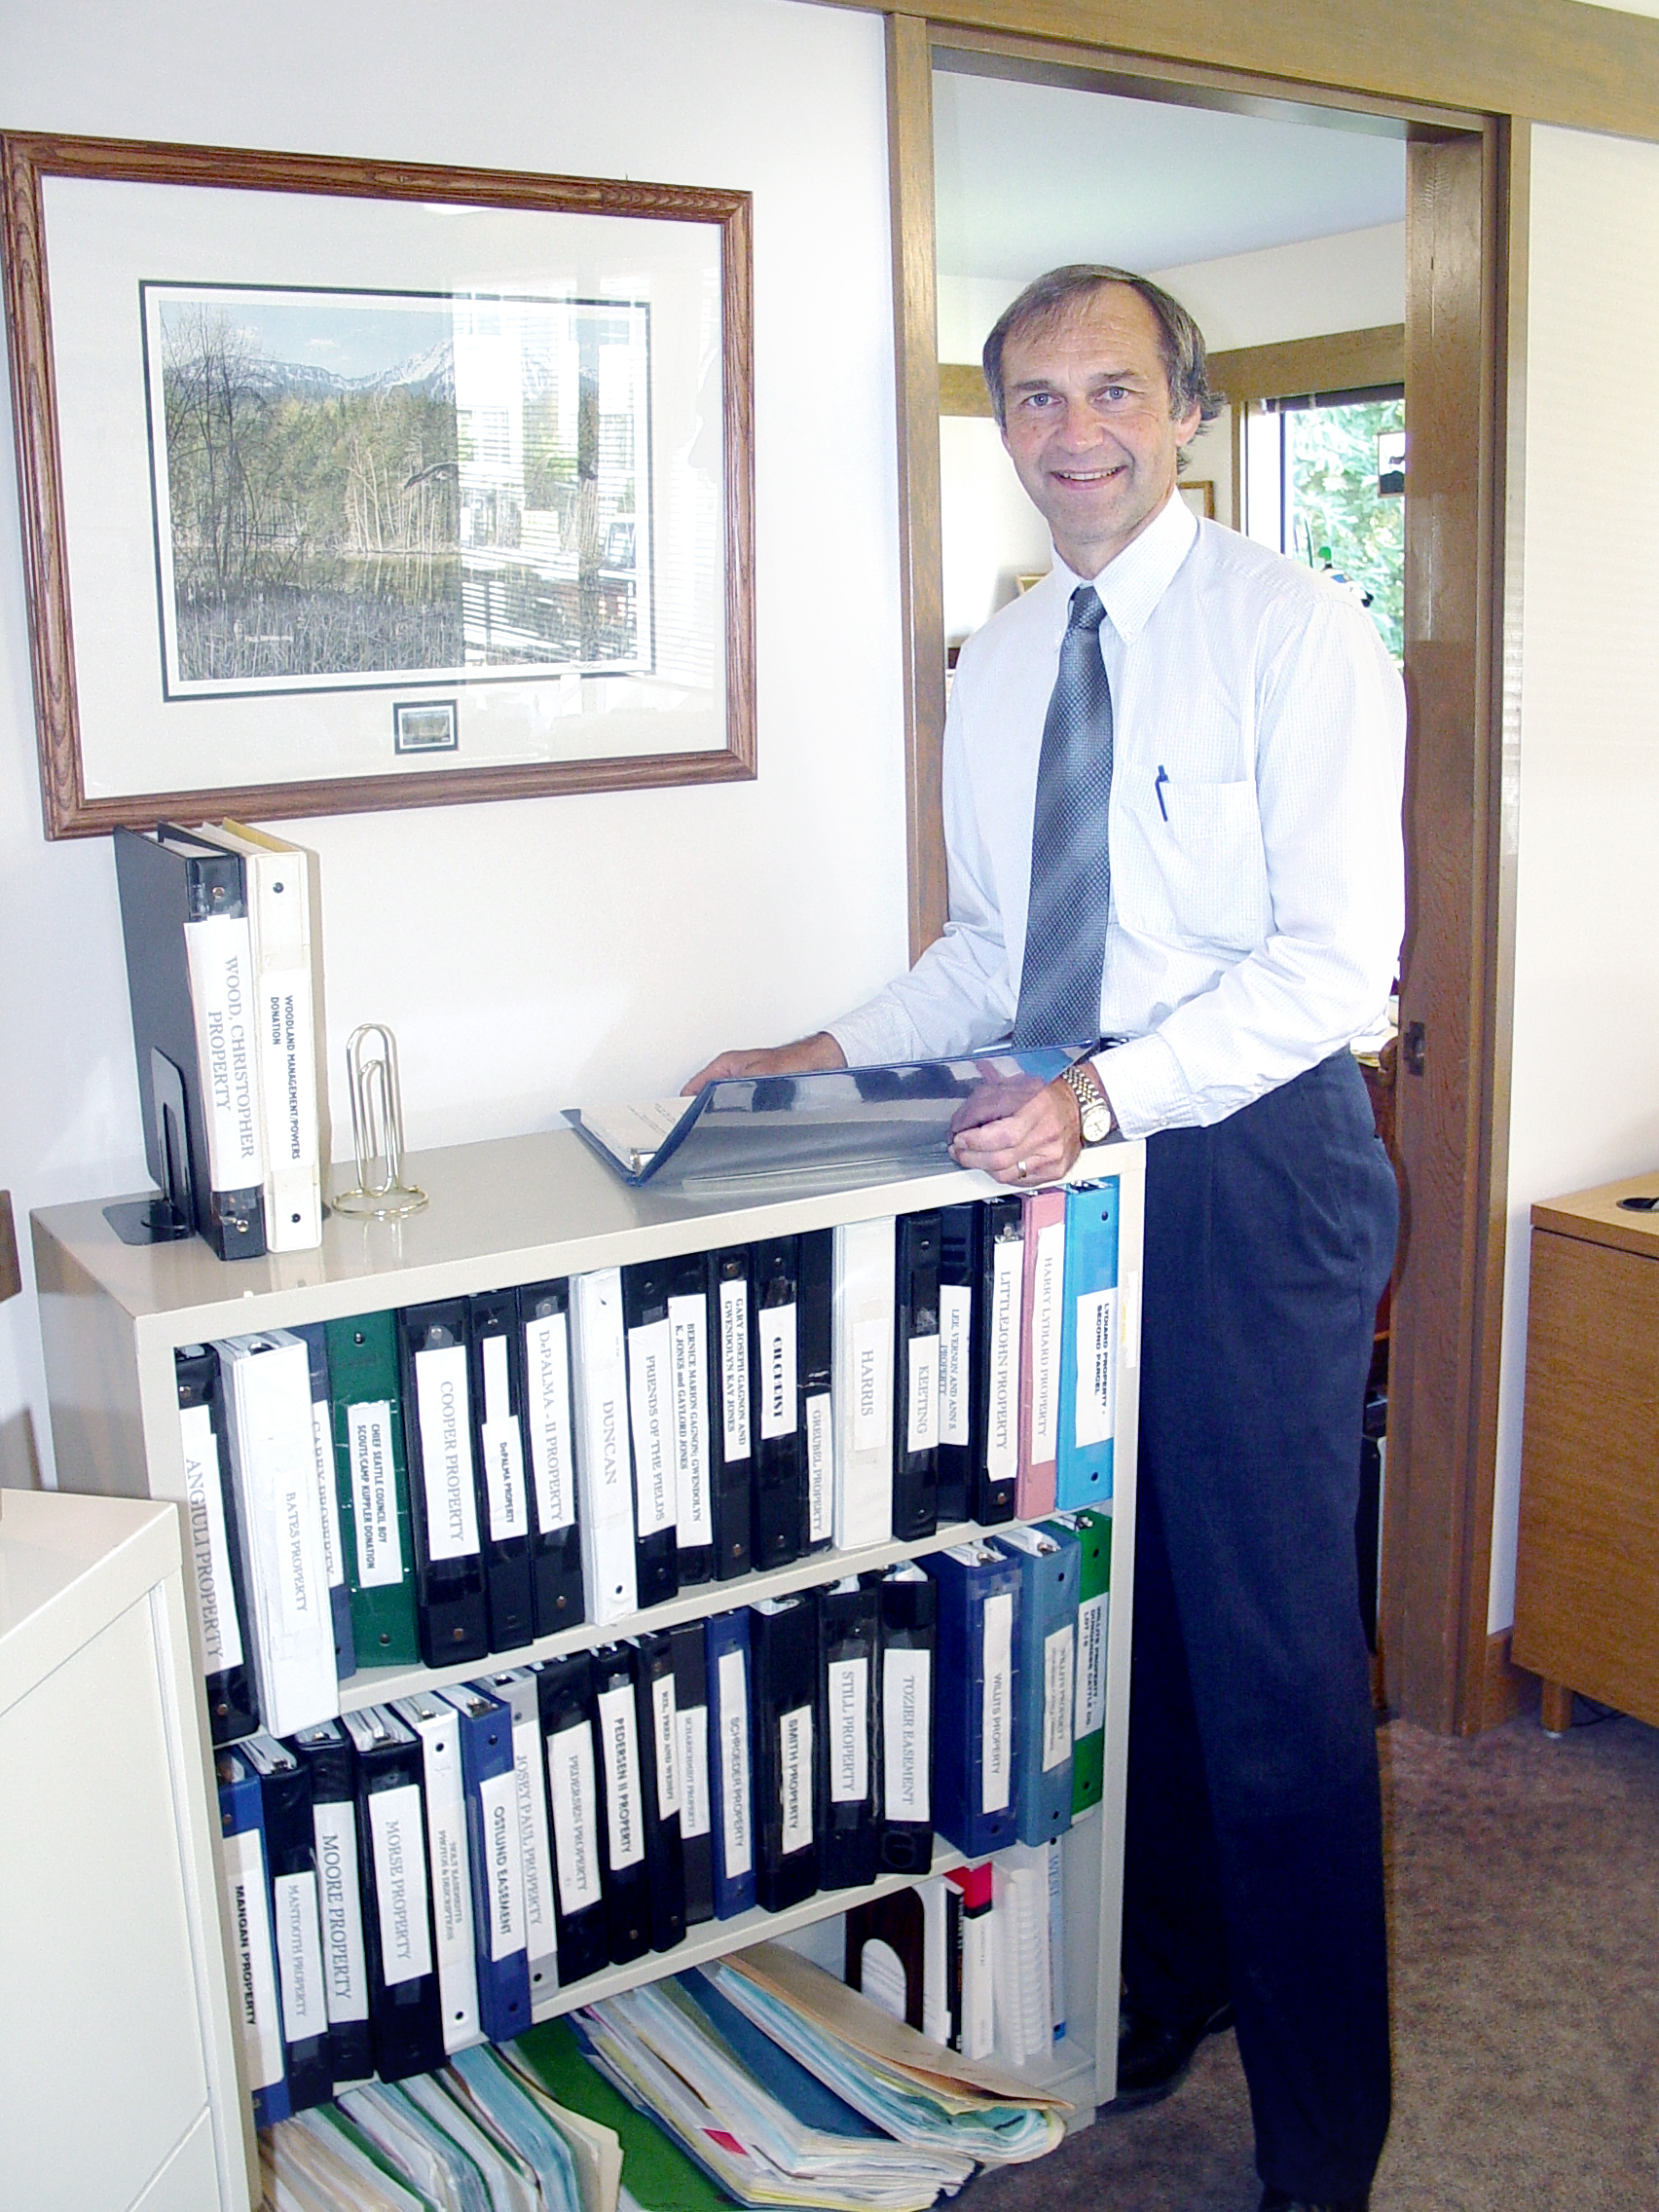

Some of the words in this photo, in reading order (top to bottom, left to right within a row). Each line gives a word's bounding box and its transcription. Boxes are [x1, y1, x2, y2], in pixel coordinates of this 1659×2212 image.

[225, 956, 241, 1020] WOOD,
[271, 997, 281, 1045] DONATION
[285, 995, 295, 1051] WOODLAND
[208, 1012, 231, 1111] PROPERTY
[231, 1025, 254, 1159] CHRISTOPHER
[287, 1054, 300, 1160] MANAGEMENT/POWERS
[1043, 1257, 1052, 1304] HARRY
[675, 1325, 683, 1336] K.
[686, 1323, 696, 1366] BERNICE
[724, 1301, 734, 1372] GWENDOLYN
[998, 1271, 1011, 1366] LITTLEJOHN
[1041, 1309, 1051, 1365] LYDIARD
[539, 1331, 554, 1409] DePALMA
[676, 1338, 685, 1370] JONES
[736, 1332, 745, 1372] JOSEPH
[773, 1337, 783, 1418] GILCHRIST
[940, 1345, 948, 1395] PROPERTY
[950, 1333, 959, 1373] VERNON
[645, 1355, 657, 1416] FRIENDS
[678, 1389, 686, 1437] GAYLORD
[688, 1370, 698, 1410] MARION
[737, 1375, 746, 1420] GAGNON
[861, 1350, 874, 1417] HARRIS
[917, 1365, 929, 1434] KEETING
[996, 1371, 1008, 1450] PROPERTY
[1038, 1369, 1049, 1437] PROPERTY
[372, 1423, 381, 1448] CHIEF
[440, 1381, 457, 1451] COOPER
[545, 1421, 557, 1433] II
[603, 1400, 617, 1485] DUNCAN
[649, 1419, 659, 1437] OF
[357, 1424, 370, 1482] SCOUTS/CAMP
[373, 1451, 384, 1485] SEATTLE
[499, 1442, 510, 1481] DePALMA
[546, 1436, 563, 1522] PROPERTY
[650, 1439, 662, 1470] THE
[185, 1458, 208, 1546] ANGIULI
[285, 1492, 300, 1538] BATES
[362, 1485, 373, 1523] KUPPLER
[376, 1488, 387, 1524] COUNCIL
[445, 1454, 463, 1541] PROPERTY
[504, 1483, 514, 1523] PROPERTY
[652, 1473, 664, 1521] FIELDS
[691, 1458, 701, 1522] GWENDOLYN
[812, 1469, 823, 1530] PROPERTY
[364, 1526, 376, 1569] DONATION
[378, 1527, 387, 1543] BOY
[196, 1552, 224, 1659] PROPERTY
[291, 1542, 308, 1612] PROPERTY
[842, 1672, 855, 1713] STILL
[903, 1677, 915, 1727] TOZIER
[992, 1673, 1003, 1715] WILLITS
[614, 1717, 627, 1781] PEDERSEN
[730, 1716, 741, 1785] SCHROEDER
[789, 1719, 798, 1760] SMITH
[842, 1715, 855, 1790] PROPERTY
[902, 1731, 913, 1805] EASEMENT
[991, 1716, 1001, 1775] PROPERTY
[516, 1755, 531, 1802] JOSEY
[569, 1755, 581, 1823] PEDERSEN
[790, 1764, 798, 1829] PROPERTY
[494, 1806, 506, 1865] OSTLUND
[520, 1804, 534, 1846] PAUL
[618, 1793, 631, 1853] PROPERTY
[733, 1788, 743, 1847] PROPERTY
[322, 1835, 344, 1902] MOORE
[386, 1821, 403, 1877] MORSE
[573, 1826, 587, 1891] PROPERTY
[498, 1870, 511, 1935] EASEMENT
[524, 1848, 541, 1925] PROPERTY
[288, 1886, 302, 1953] MANTOOTH
[390, 1880, 411, 1960] PROPERTY
[328, 1907, 350, 1999] PROPERTY
[241, 1953, 256, 2025] PROPERTY
[292, 1956, 307, 2017] PROPERTY
